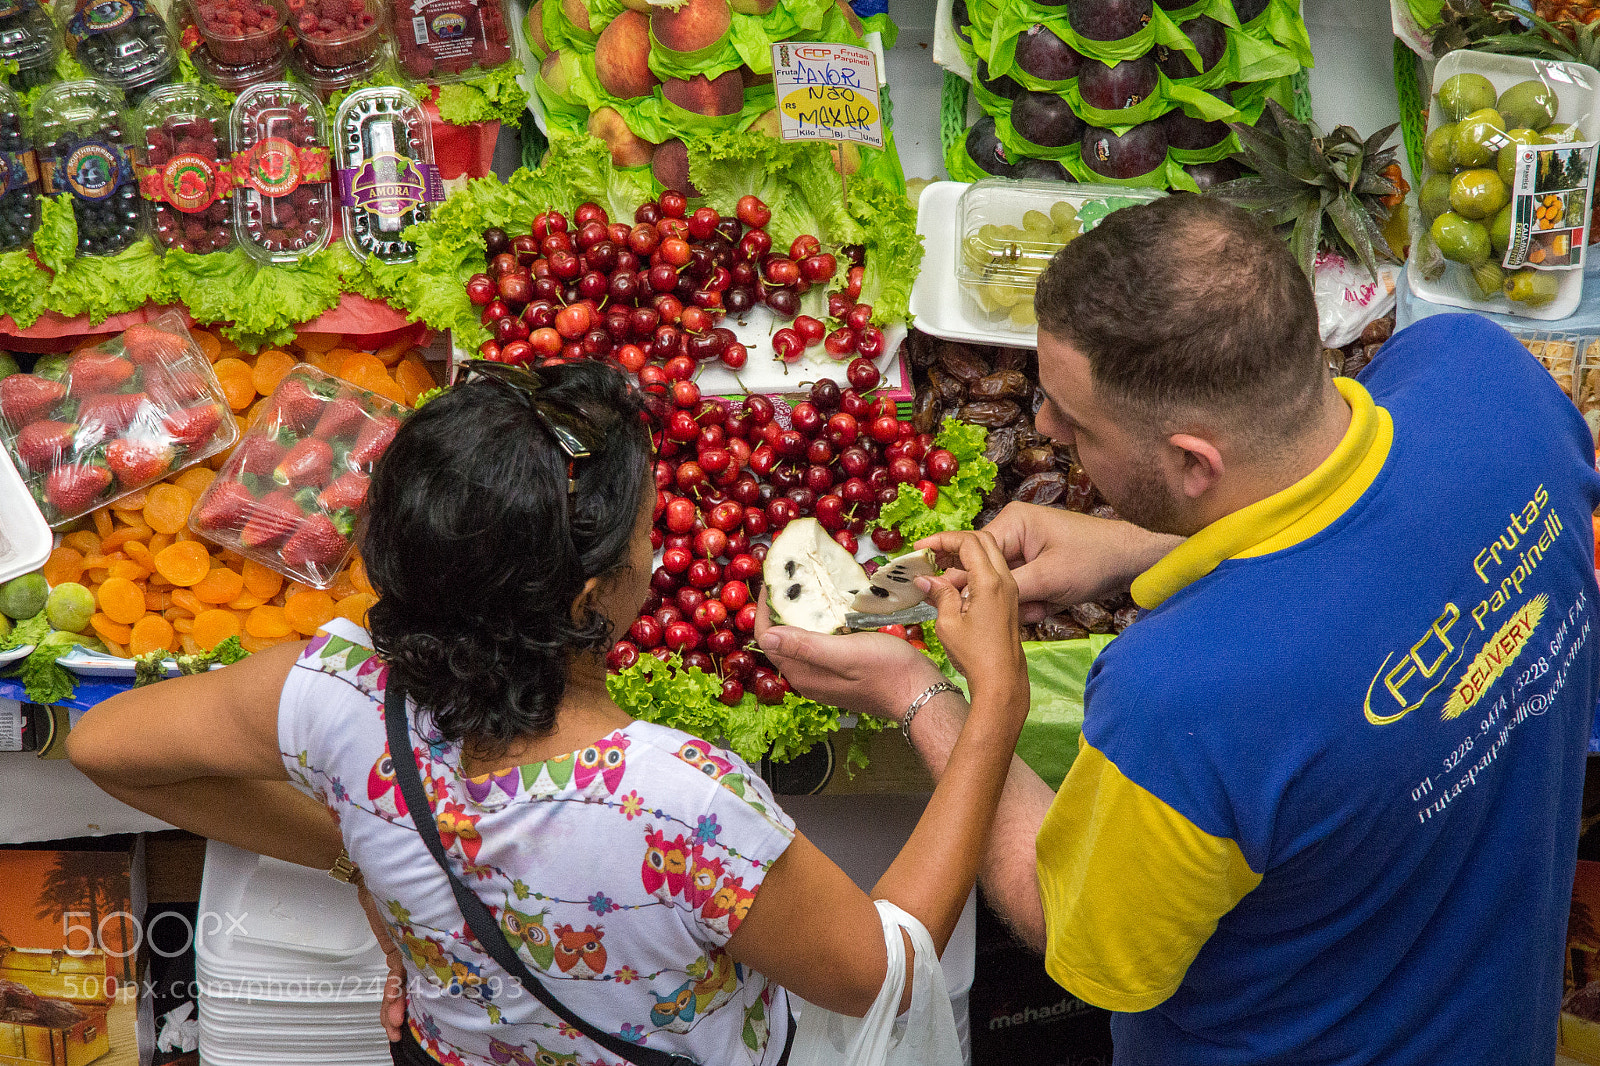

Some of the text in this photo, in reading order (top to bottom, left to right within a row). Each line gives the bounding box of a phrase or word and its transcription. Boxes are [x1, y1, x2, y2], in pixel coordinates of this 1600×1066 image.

[803, 48, 869, 60] FCP Frutas
[833, 54, 870, 67] Parpinelli
[369, 186, 410, 199] AMORA
[1473, 483, 1549, 584] Frutas
[1384, 508, 1563, 708] FCP Parpinelli
[1568, 586, 1587, 626] FAX
[1459, 612, 1531, 705] DELIVERY
